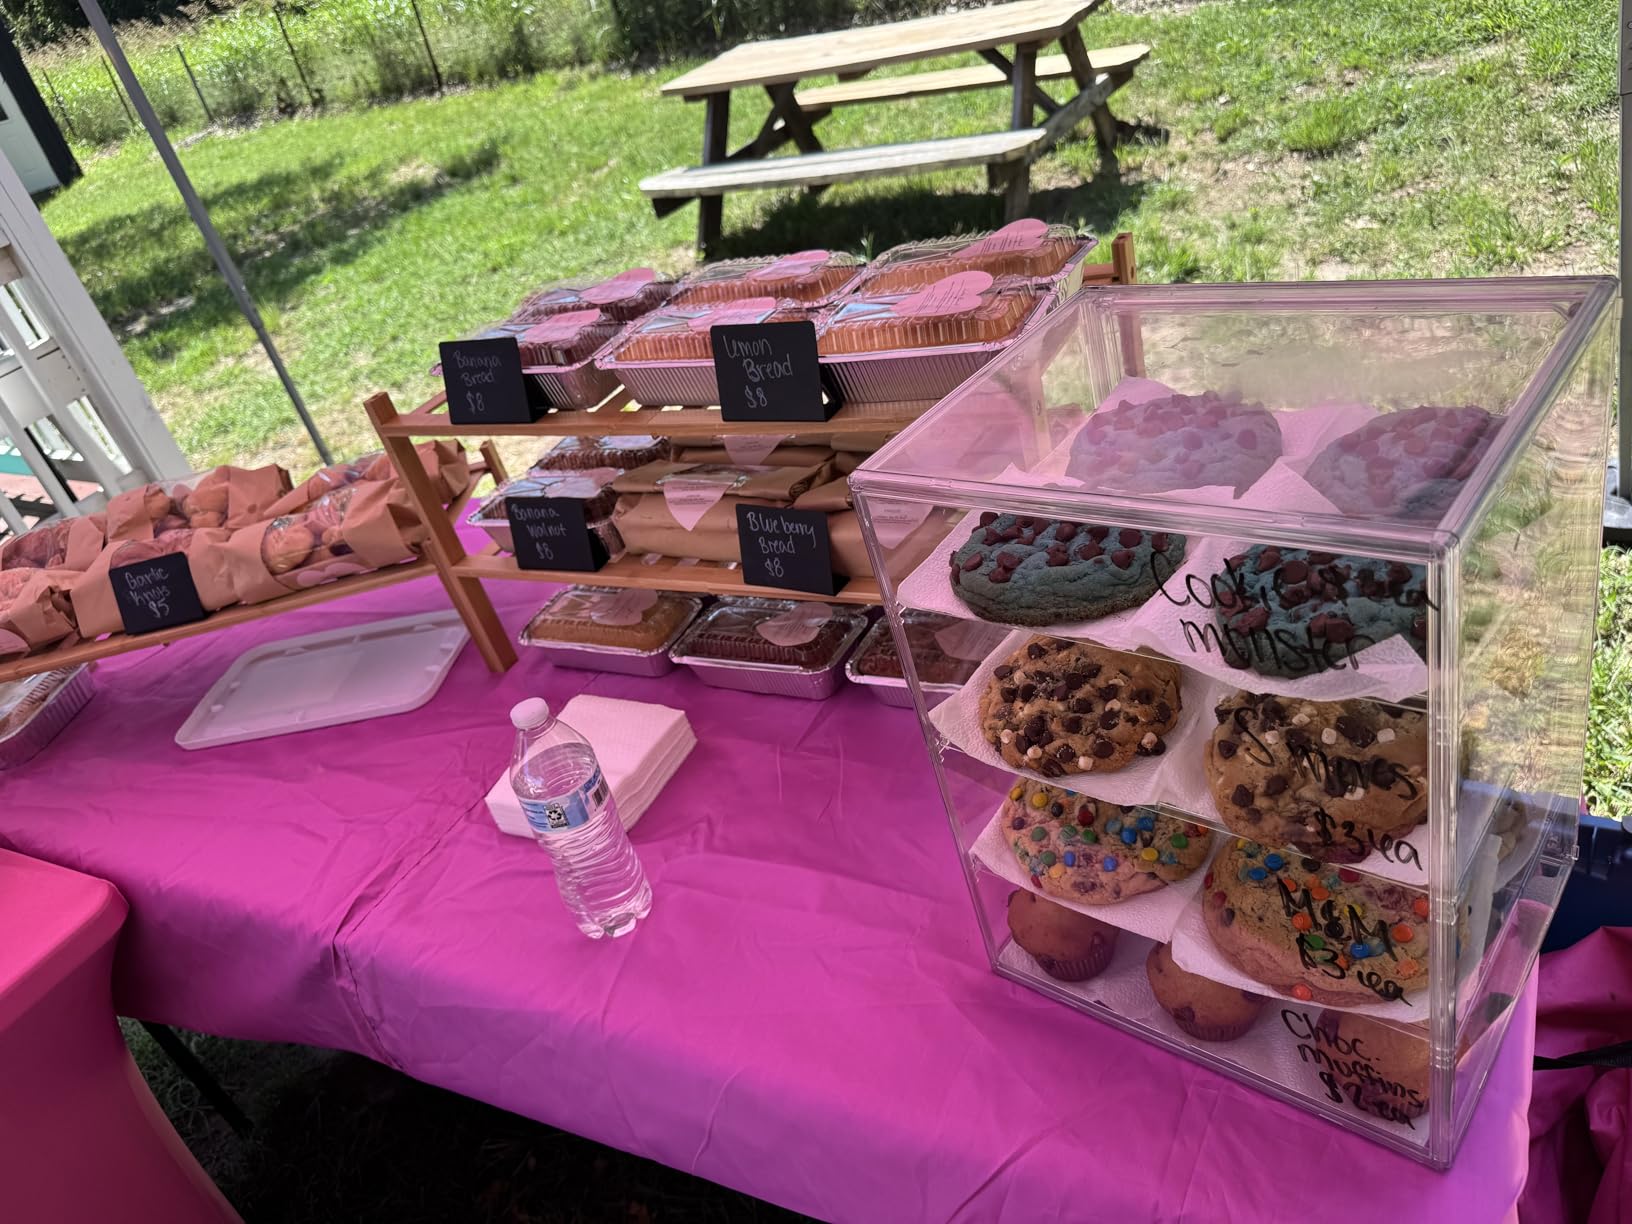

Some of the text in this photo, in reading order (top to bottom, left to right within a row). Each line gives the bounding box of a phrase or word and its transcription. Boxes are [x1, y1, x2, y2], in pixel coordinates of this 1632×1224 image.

[722, 335, 773, 359] Lemon
[452, 350, 503, 369] Banana
[742, 353, 794, 383] Bread
[461, 369, 496, 387] Bread
[466, 391, 486, 414] $8
[744, 385, 768, 408] $8
[511, 503, 560, 521] Banana
[758, 535, 796, 554] Bread
[764, 557, 785, 578] $8
[148, 598, 170, 619] $5
